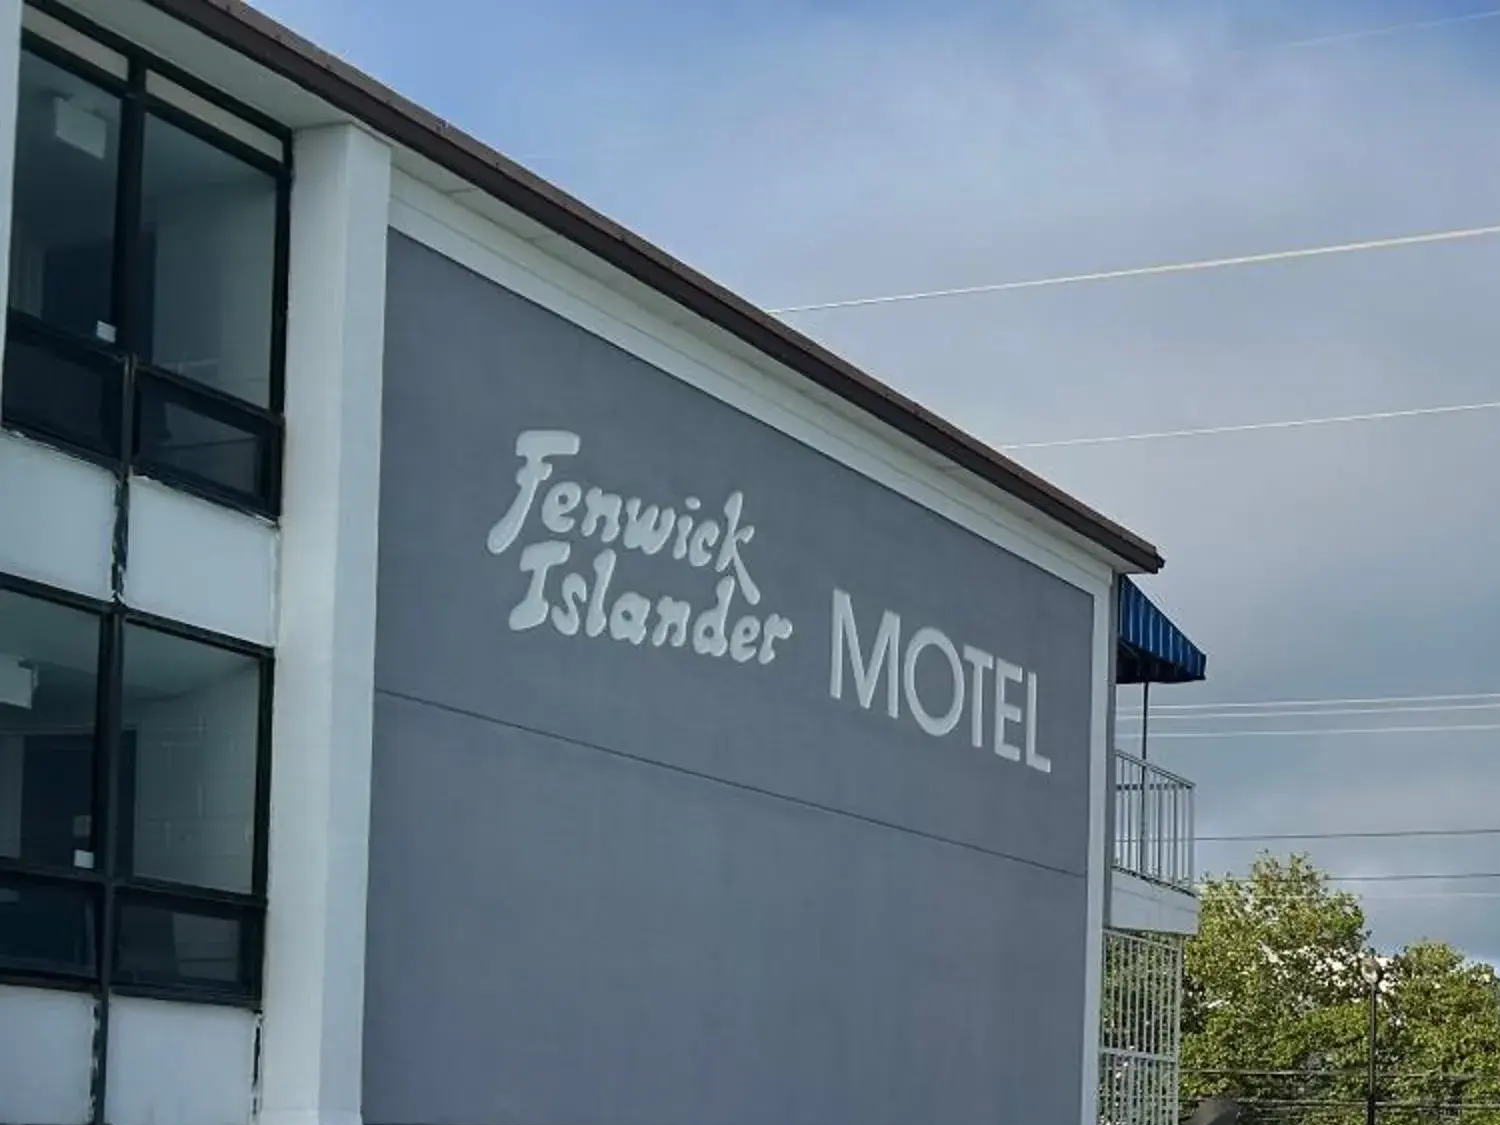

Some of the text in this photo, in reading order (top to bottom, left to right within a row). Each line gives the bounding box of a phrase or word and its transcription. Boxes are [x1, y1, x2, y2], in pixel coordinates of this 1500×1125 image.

[487, 430, 760, 604] Fenwick
[508, 540, 793, 664] Islander
[830, 586, 1051, 773] MOTEL
